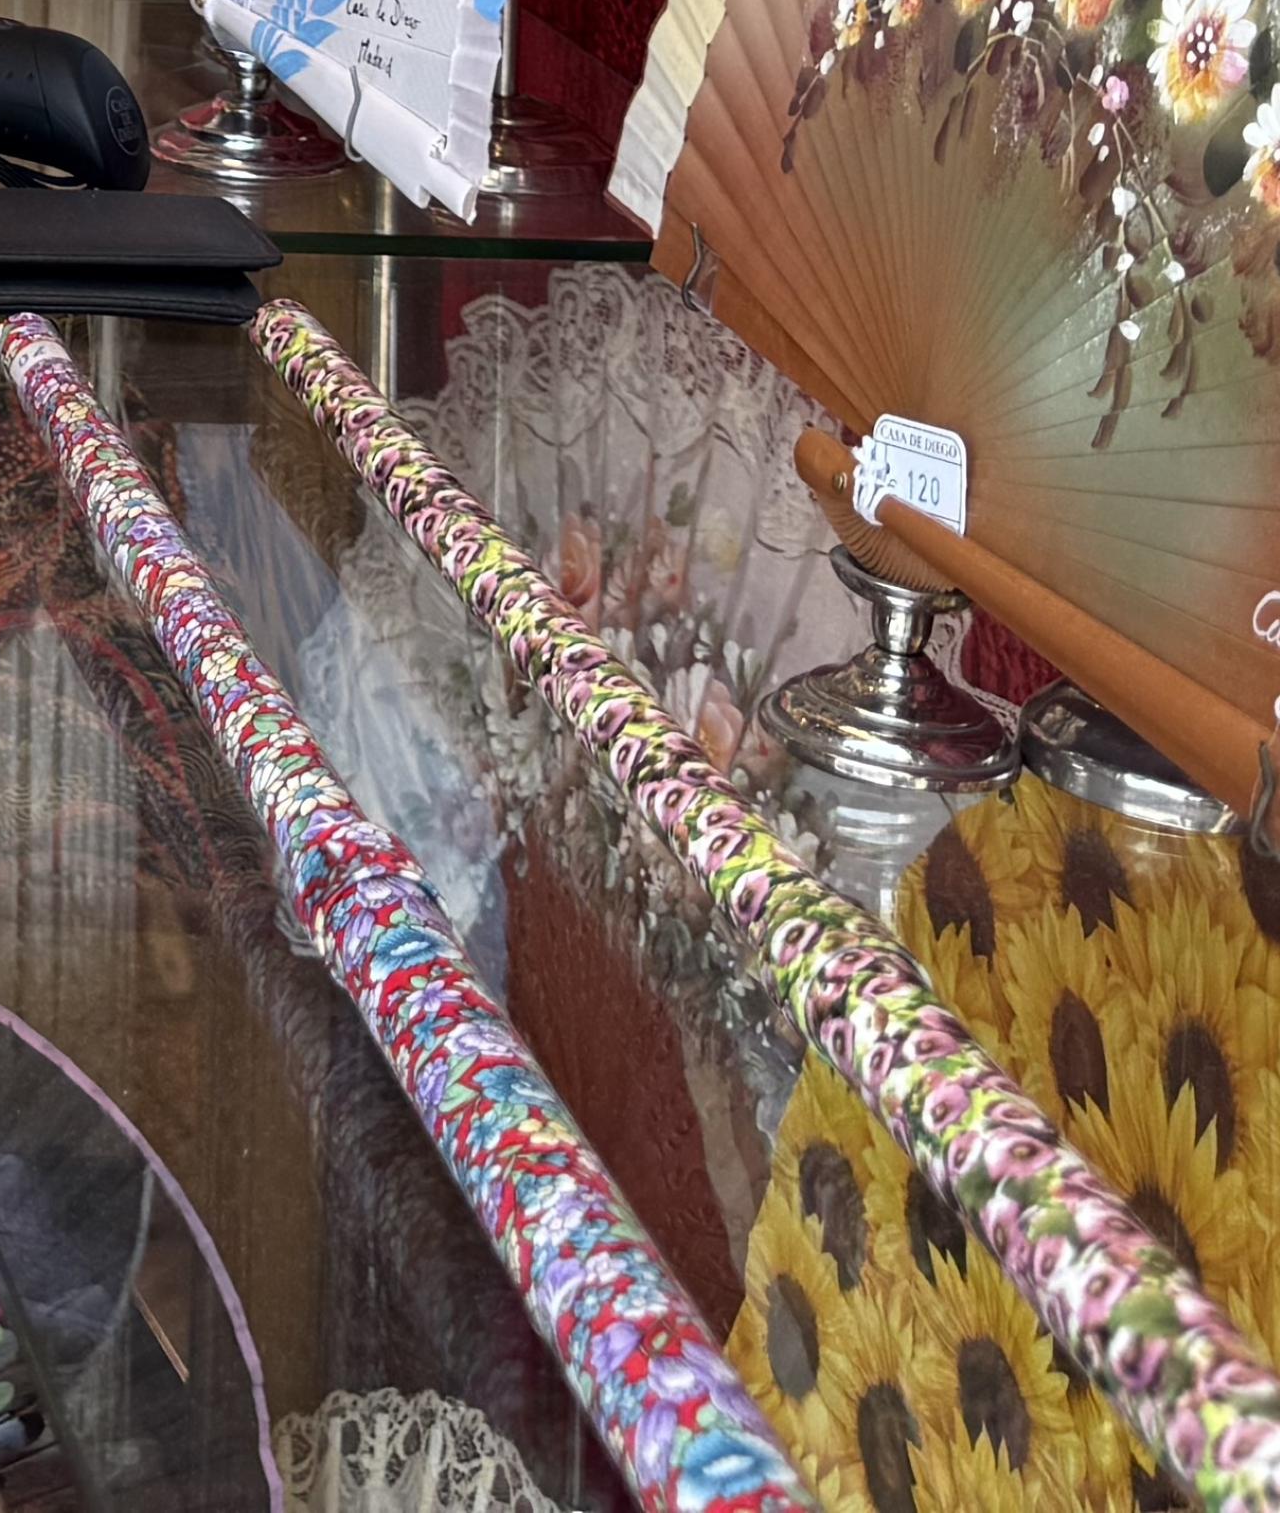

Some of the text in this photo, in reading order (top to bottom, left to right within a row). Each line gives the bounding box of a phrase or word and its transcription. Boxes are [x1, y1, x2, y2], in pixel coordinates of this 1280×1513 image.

[880, 424, 958, 459] CASA DE DIEGO
[907, 469, 941, 507] 120
